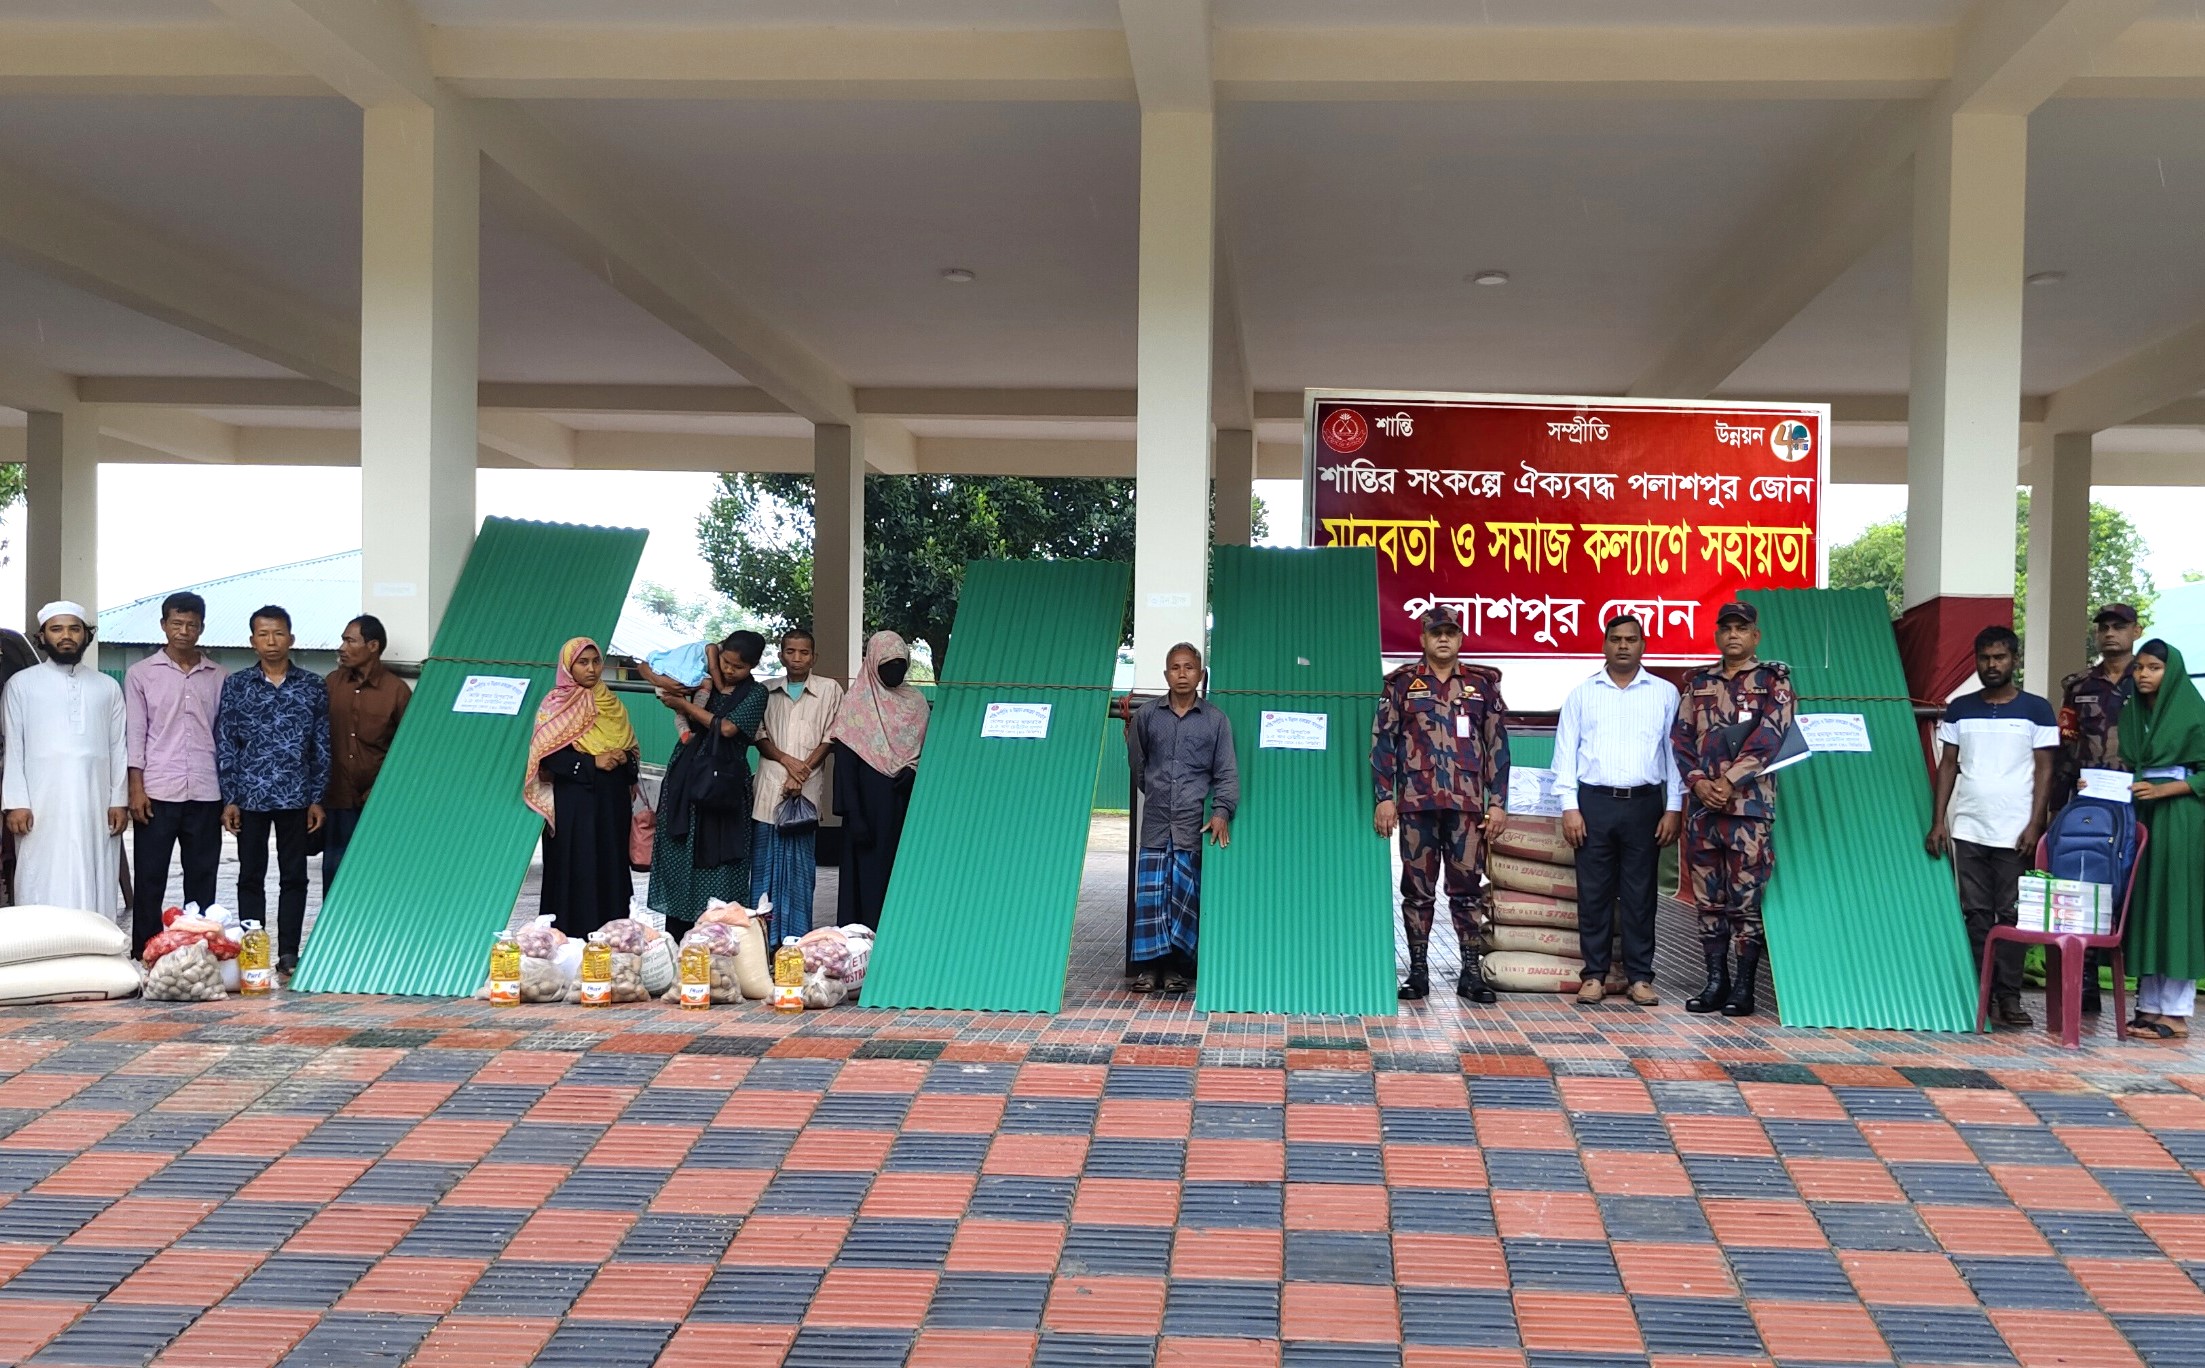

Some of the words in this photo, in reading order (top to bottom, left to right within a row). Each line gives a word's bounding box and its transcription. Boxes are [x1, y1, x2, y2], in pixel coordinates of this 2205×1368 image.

[1375, 411, 1414, 437] শান্তি
[1547, 415, 1611, 445] সম্প্রীতি
[1715, 419, 1765, 448] উন্নয়ন
[1317, 457, 1398, 495] শান্তির
[1405, 468, 1505, 499] সংকল্পে
[1514, 459, 1618, 501] ঐক্যবদ্ধ
[1627, 471, 1742, 509] পলাশপুর
[1750, 474, 1815, 504] জোন
[1450, 523, 1475, 568] ও
[1485, 517, 1574, 574] সমাজ
[1580, 517, 1692, 576] কল্যাণে
[1698, 520, 1814, 580] সহায়তা
[1546, 910, 1577, 920] STRO
[1527, 966, 1571, 976] STRONG
